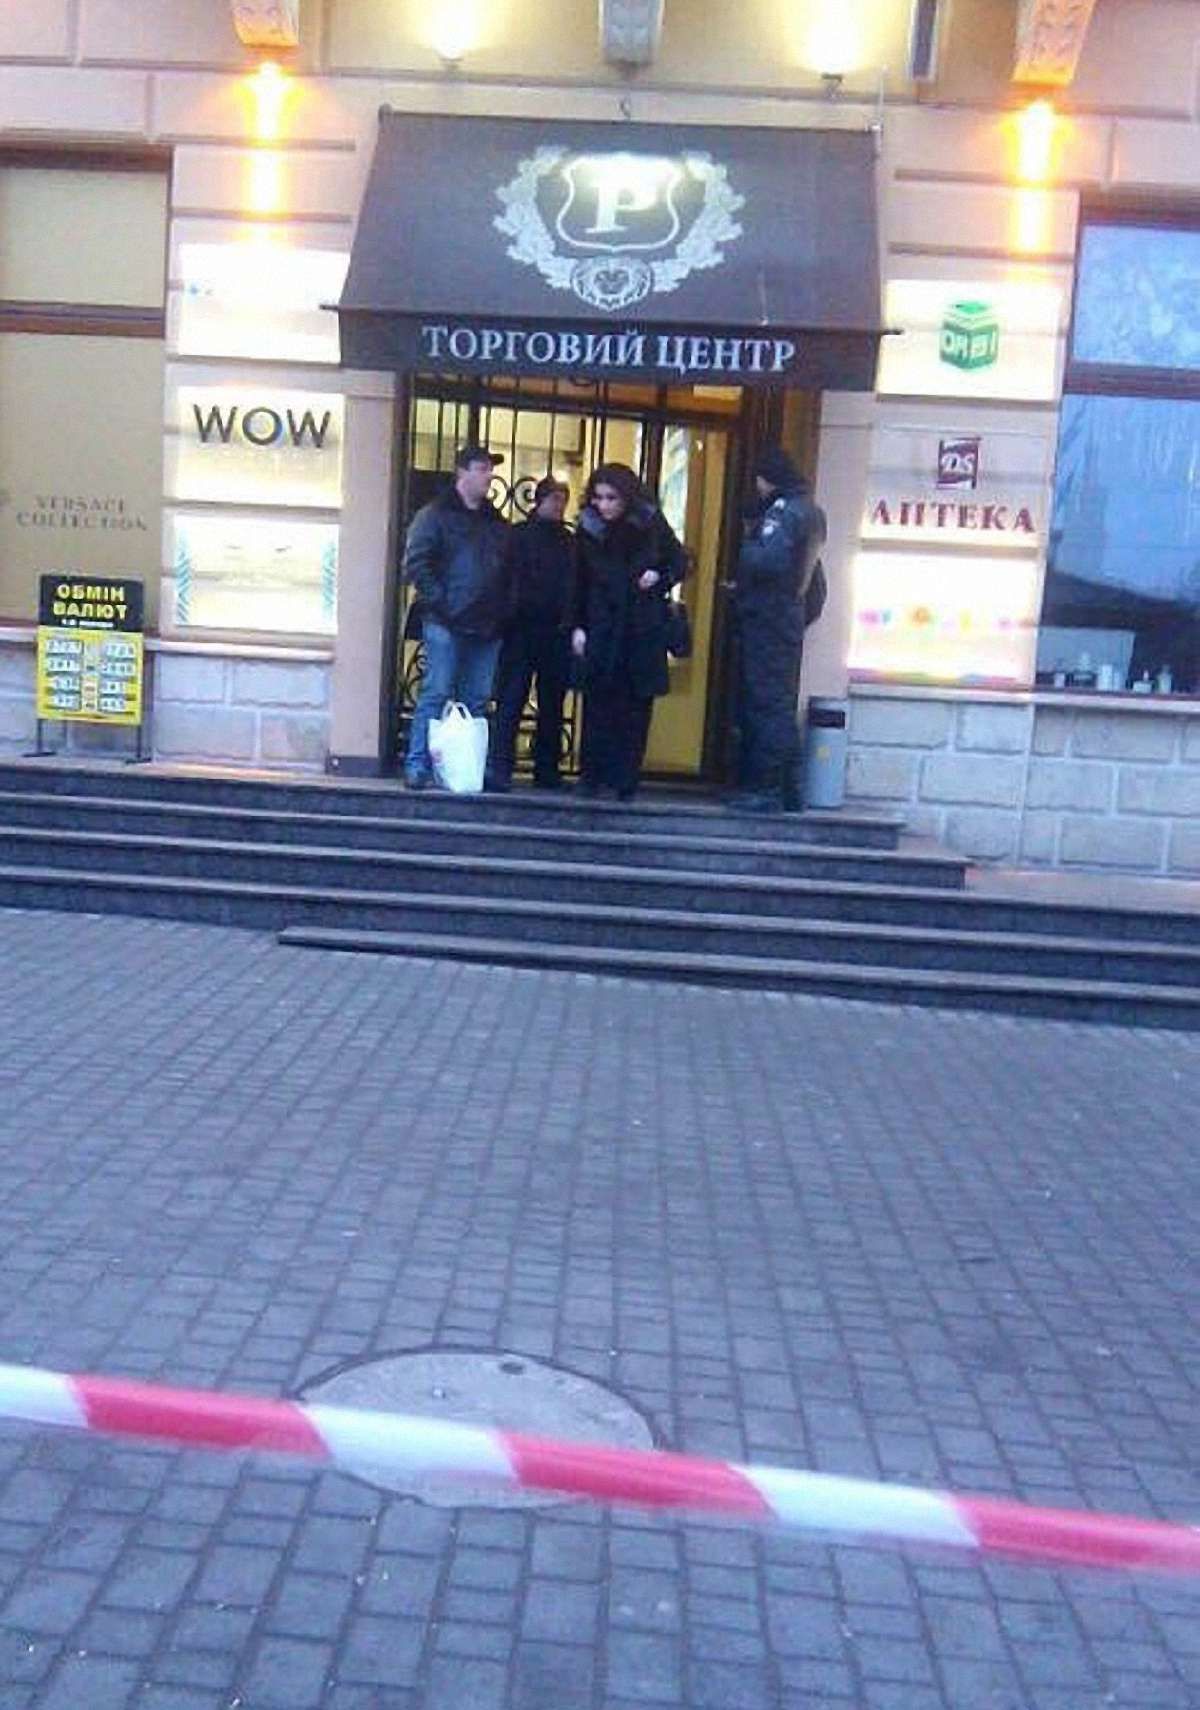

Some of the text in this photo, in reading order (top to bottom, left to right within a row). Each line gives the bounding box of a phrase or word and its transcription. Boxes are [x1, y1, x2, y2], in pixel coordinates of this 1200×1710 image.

[422, 325, 795, 375] ТОРГОВИЙ ЦЕНТР
[193, 404, 331, 448] WOW
[873, 498, 1036, 533] АПТЕКА
[53, 600, 128, 620] ВАЛЮТ
[56, 583, 125, 602] ОБМІН
